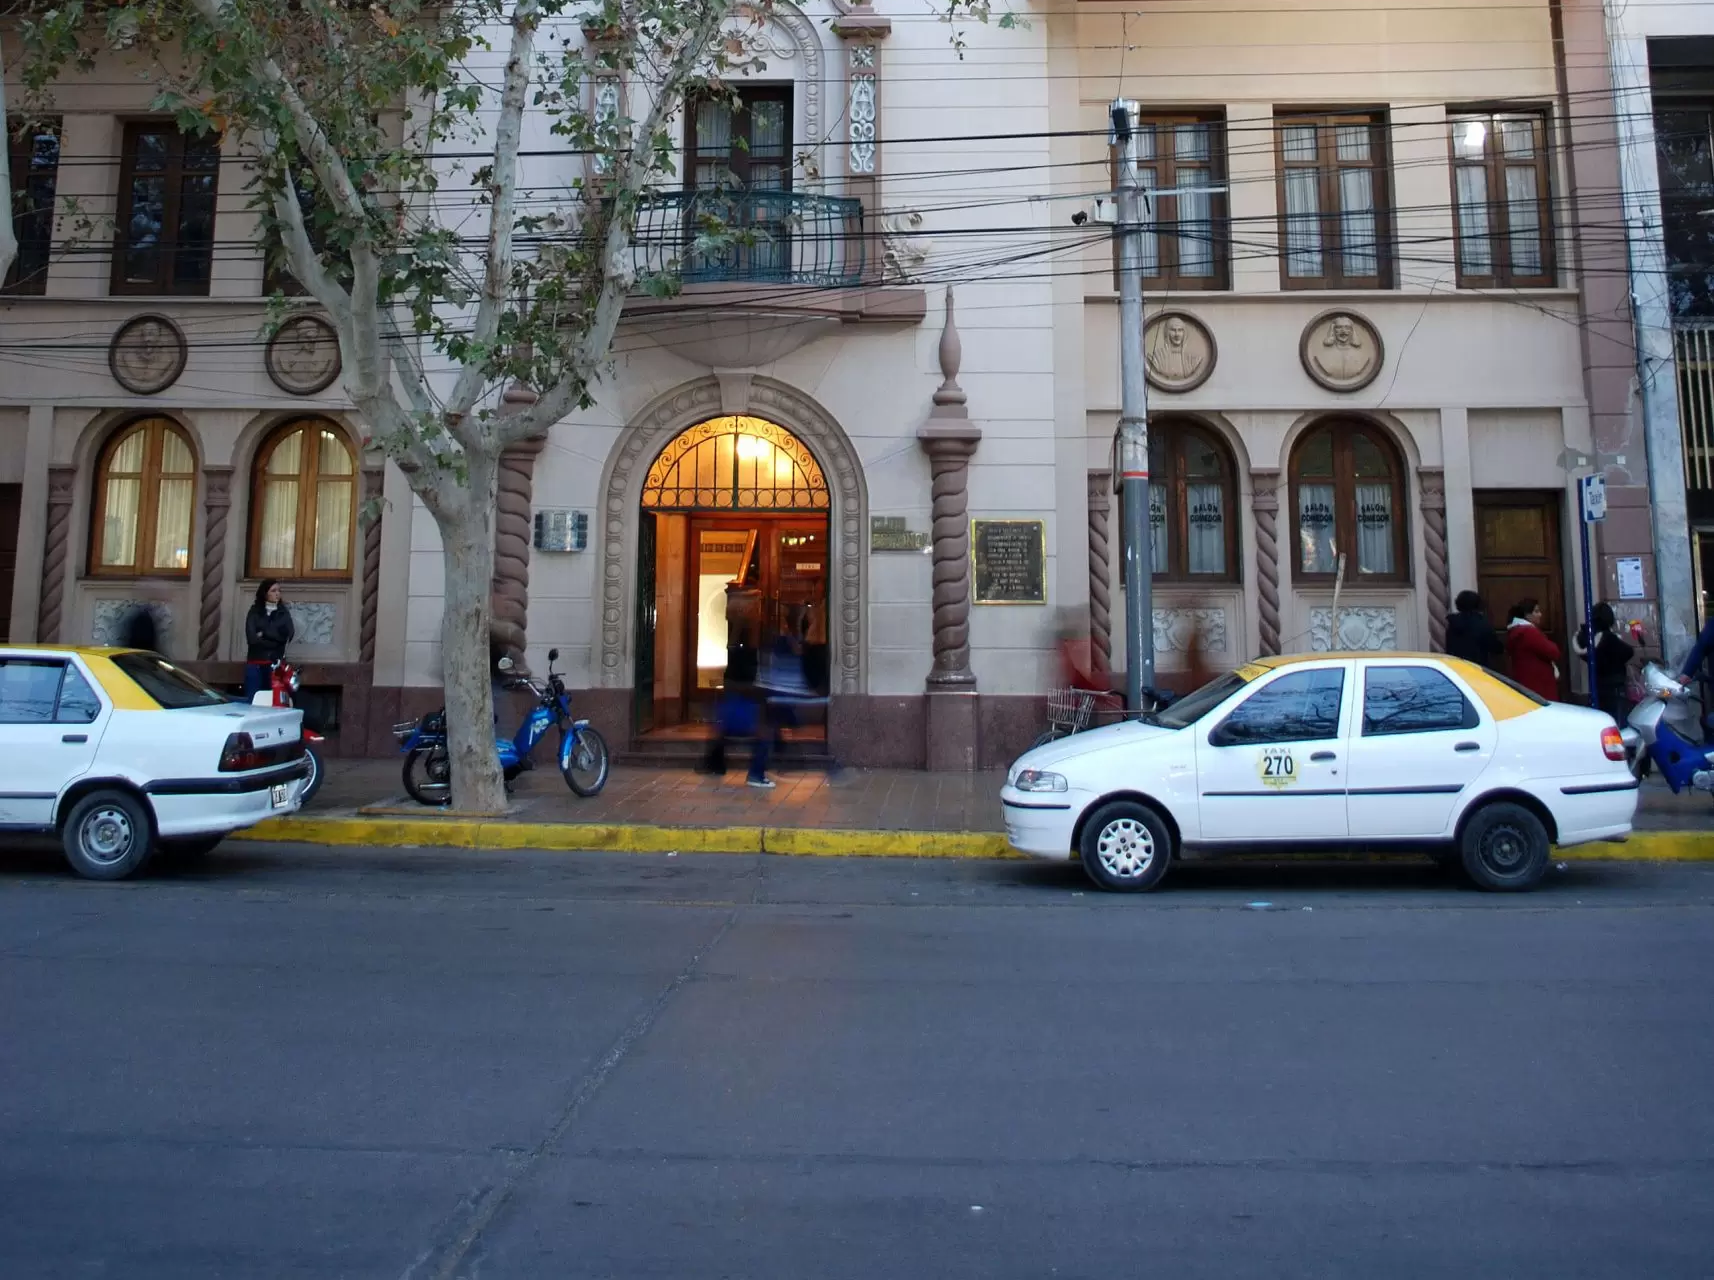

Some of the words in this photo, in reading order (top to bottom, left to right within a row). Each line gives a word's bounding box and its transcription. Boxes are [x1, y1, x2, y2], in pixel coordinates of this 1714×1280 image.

[1190, 514, 1222, 524] COMEDOR
[1301, 514, 1333, 522] COMEDOR
[1357, 514, 1390, 522] COMEDOR
[1263, 755, 1294, 776] 270
